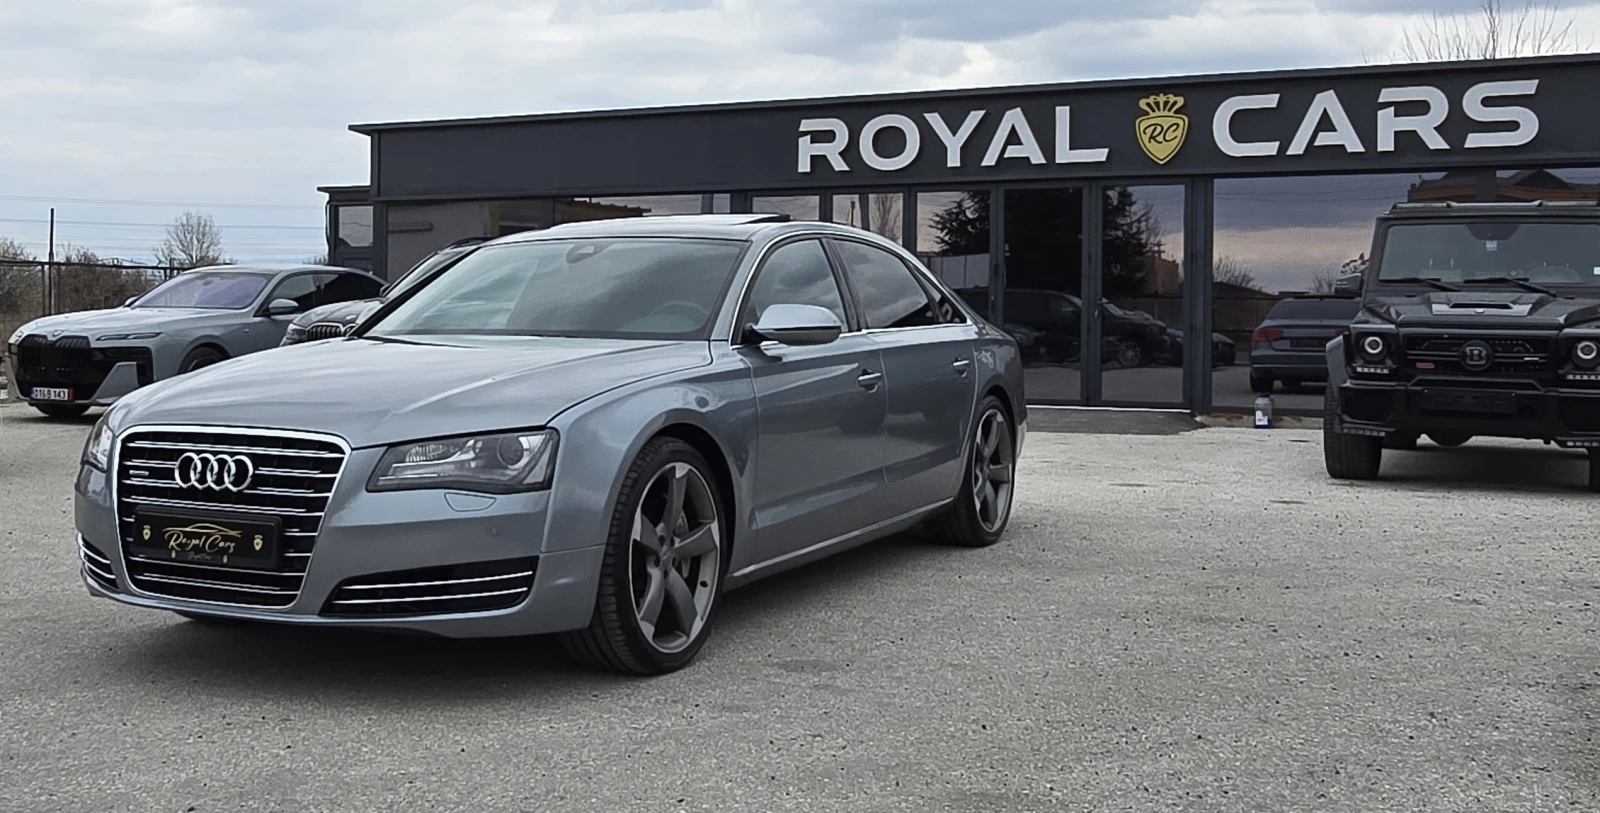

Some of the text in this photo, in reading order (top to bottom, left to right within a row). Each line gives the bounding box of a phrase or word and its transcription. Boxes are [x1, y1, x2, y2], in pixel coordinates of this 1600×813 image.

[797, 78, 1540, 173] ROYAL CARS
[1142, 122, 1180, 145] RC
[164, 530, 236, 553] Royal Cars
